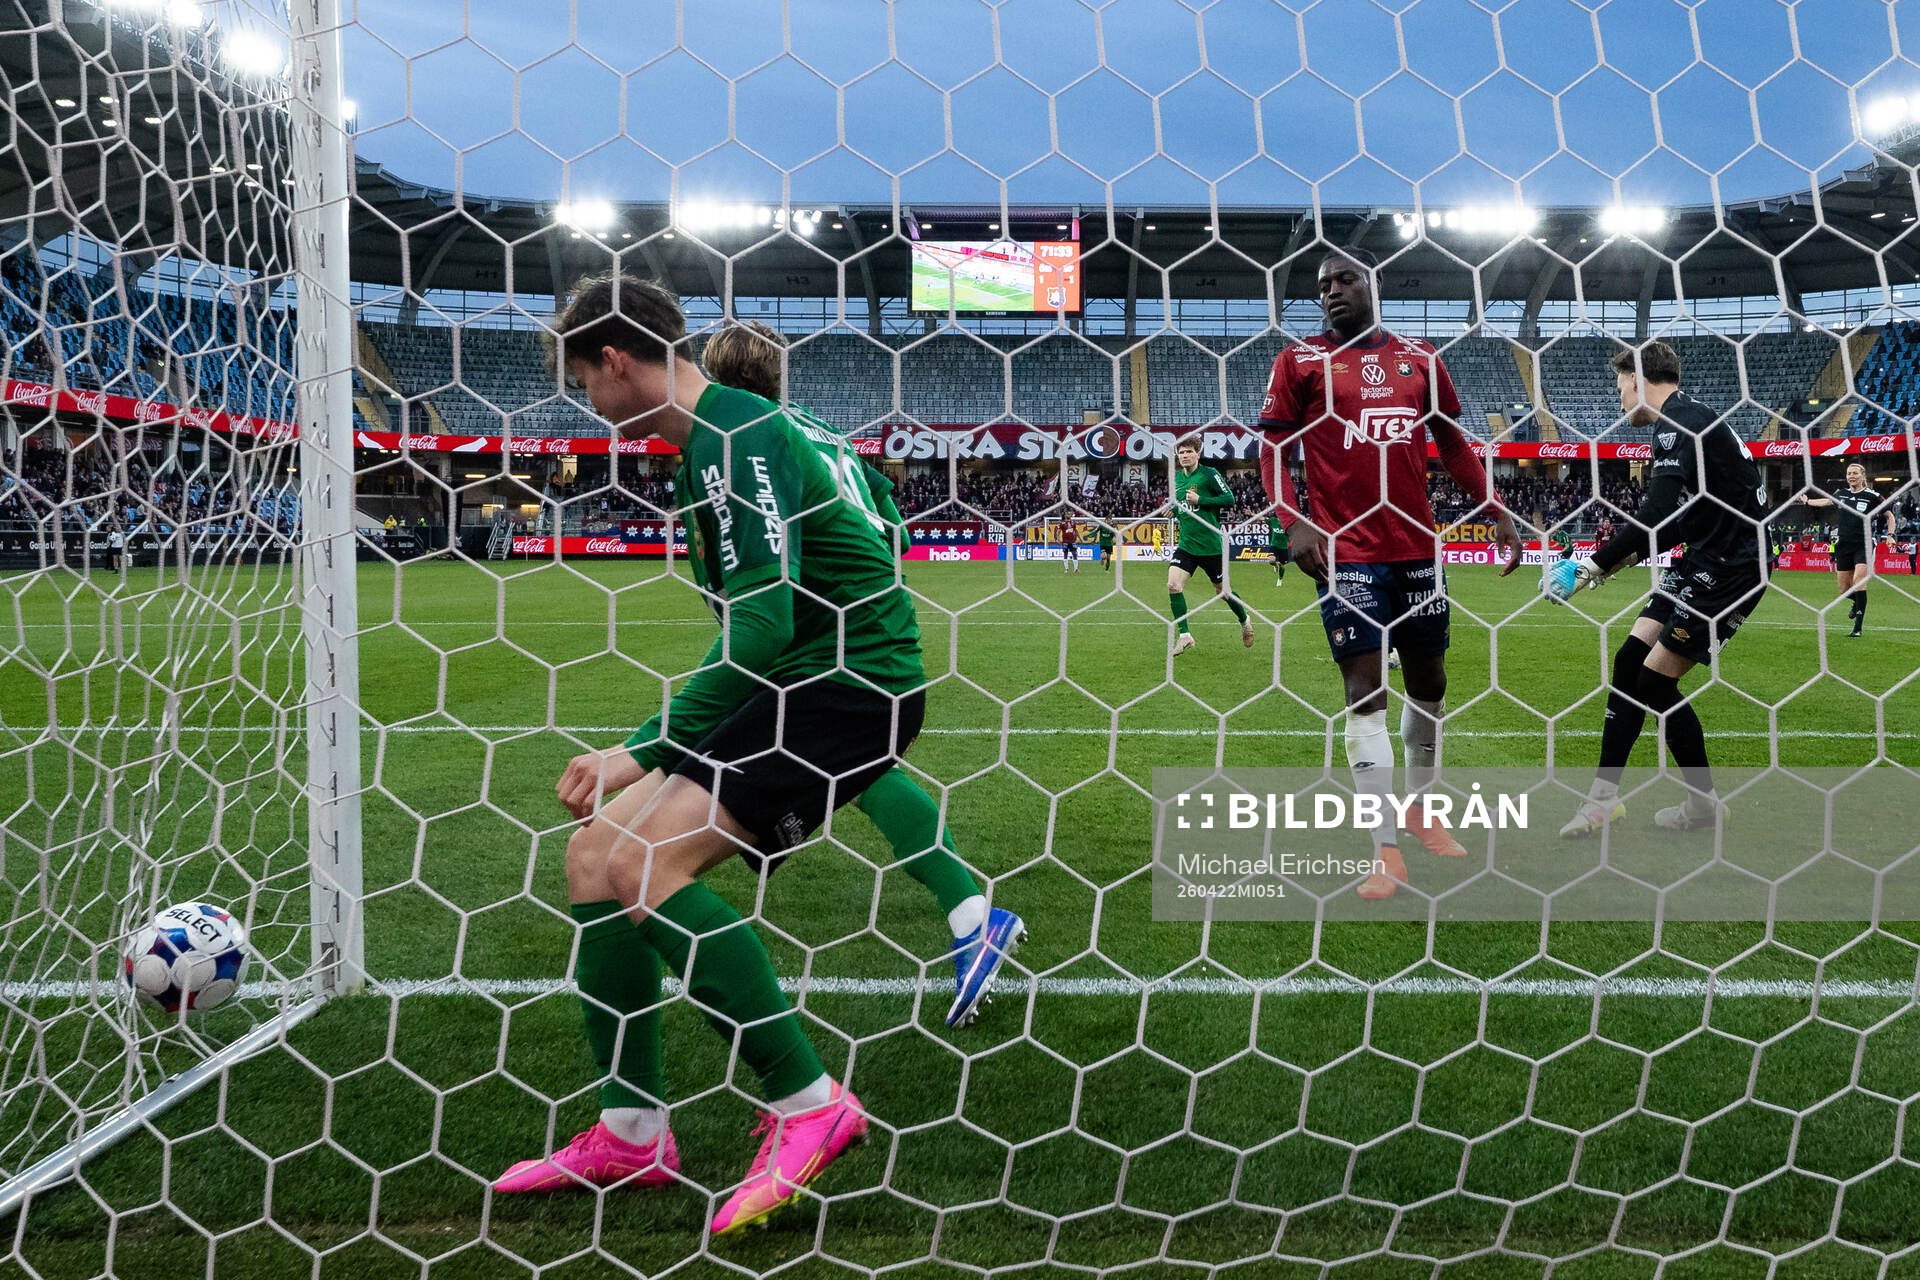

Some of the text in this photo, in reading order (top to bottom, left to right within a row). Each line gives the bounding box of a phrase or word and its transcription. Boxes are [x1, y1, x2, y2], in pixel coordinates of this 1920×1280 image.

[885, 425, 1005, 459] ÖSTRA
[1017, 425, 1088, 460] STÅ
[1539, 443, 1580, 458] Coca-Cola
[1860, 436, 1897, 453] Coca-Cola
[1335, 571, 1373, 584] esslau
[1347, 626, 1357, 640] 2
[166, 908, 222, 943] SELECT
